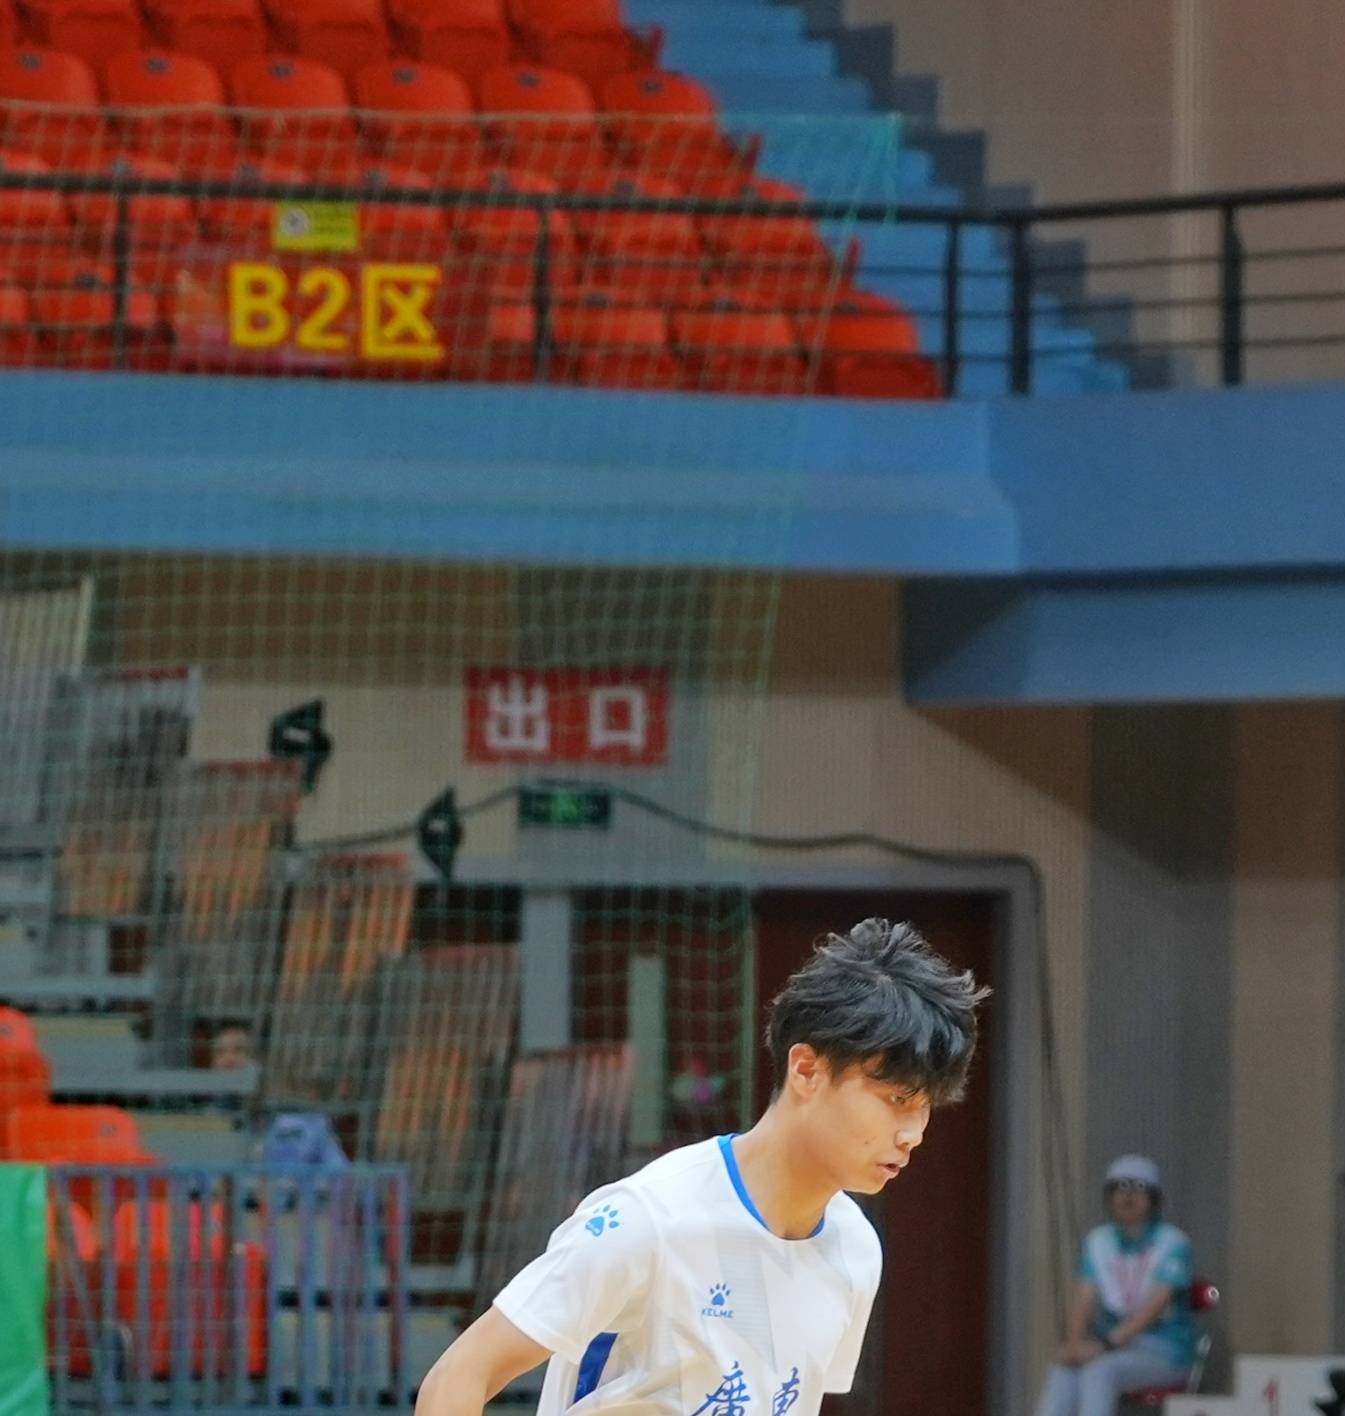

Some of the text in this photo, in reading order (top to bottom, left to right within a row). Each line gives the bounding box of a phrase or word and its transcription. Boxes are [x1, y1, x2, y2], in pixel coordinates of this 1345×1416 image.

[230, 262, 446, 362] B2区
[486, 676, 647, 751] 出口
[702, 1307, 735, 1319] KELME
